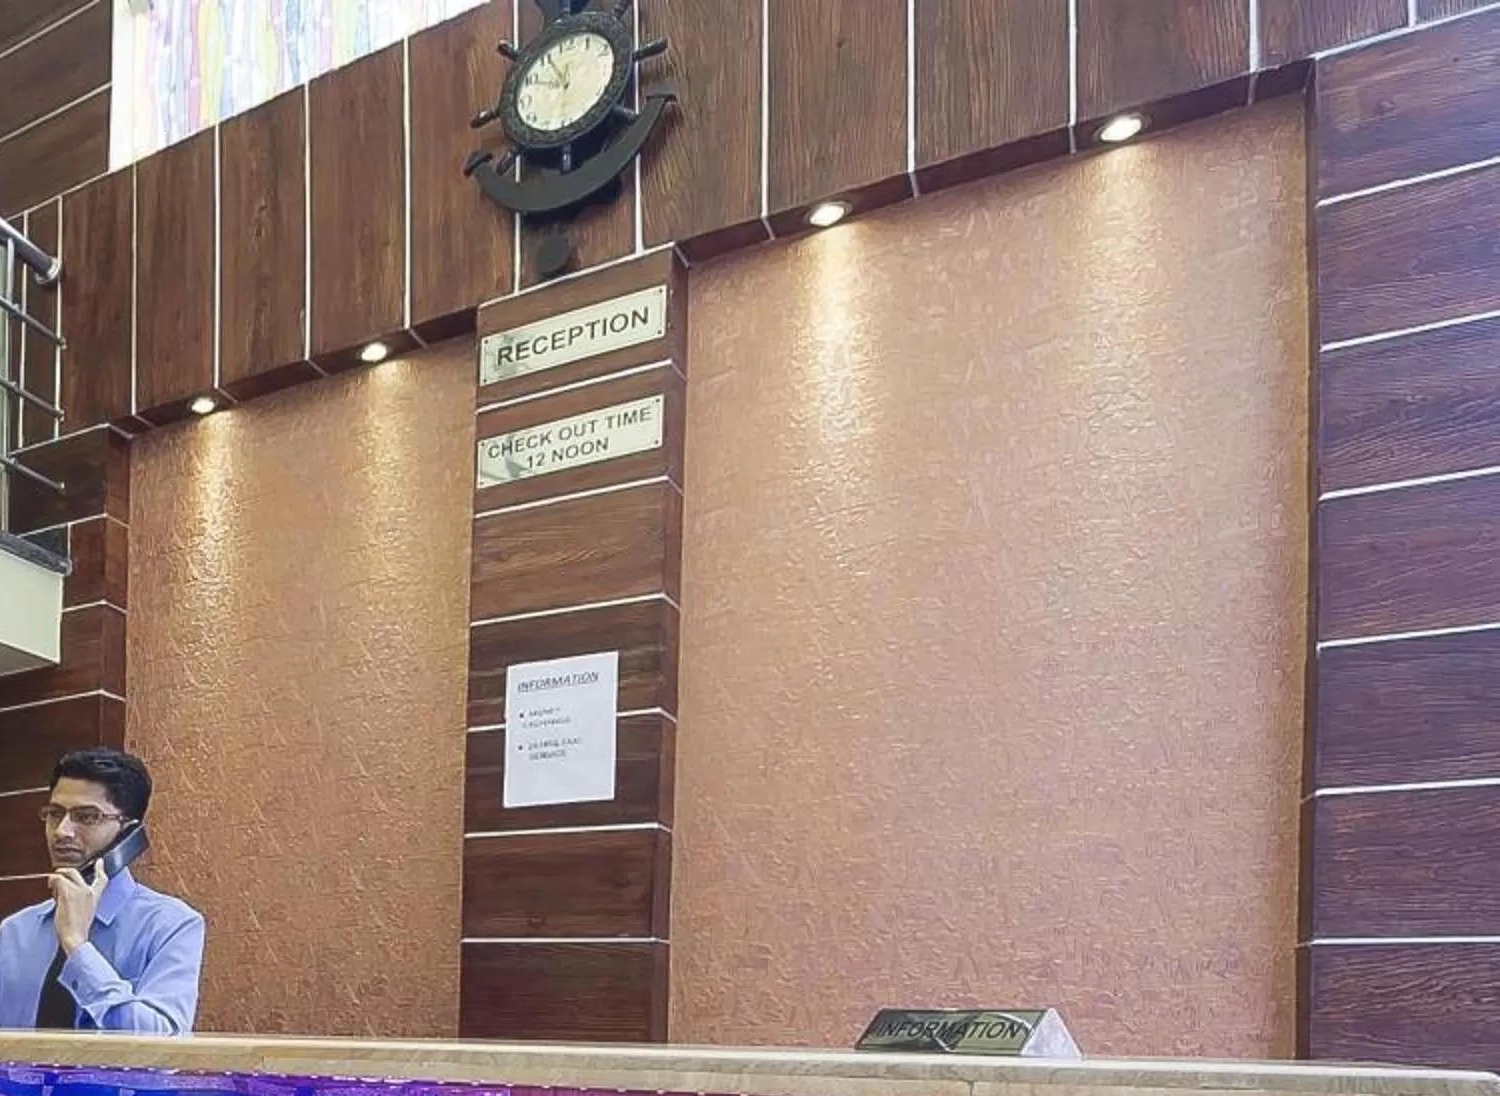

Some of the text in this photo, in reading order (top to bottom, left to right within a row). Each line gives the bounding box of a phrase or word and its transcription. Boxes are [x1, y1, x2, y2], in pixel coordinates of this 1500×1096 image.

[497, 306, 649, 366] RECEPTION
[487, 405, 652, 459] CHECK OUT TIME
[526, 436, 609, 470] 12 NOON
[517, 672, 600, 693] INFORMATION
[876, 1020, 1021, 1042] INFORMATION
